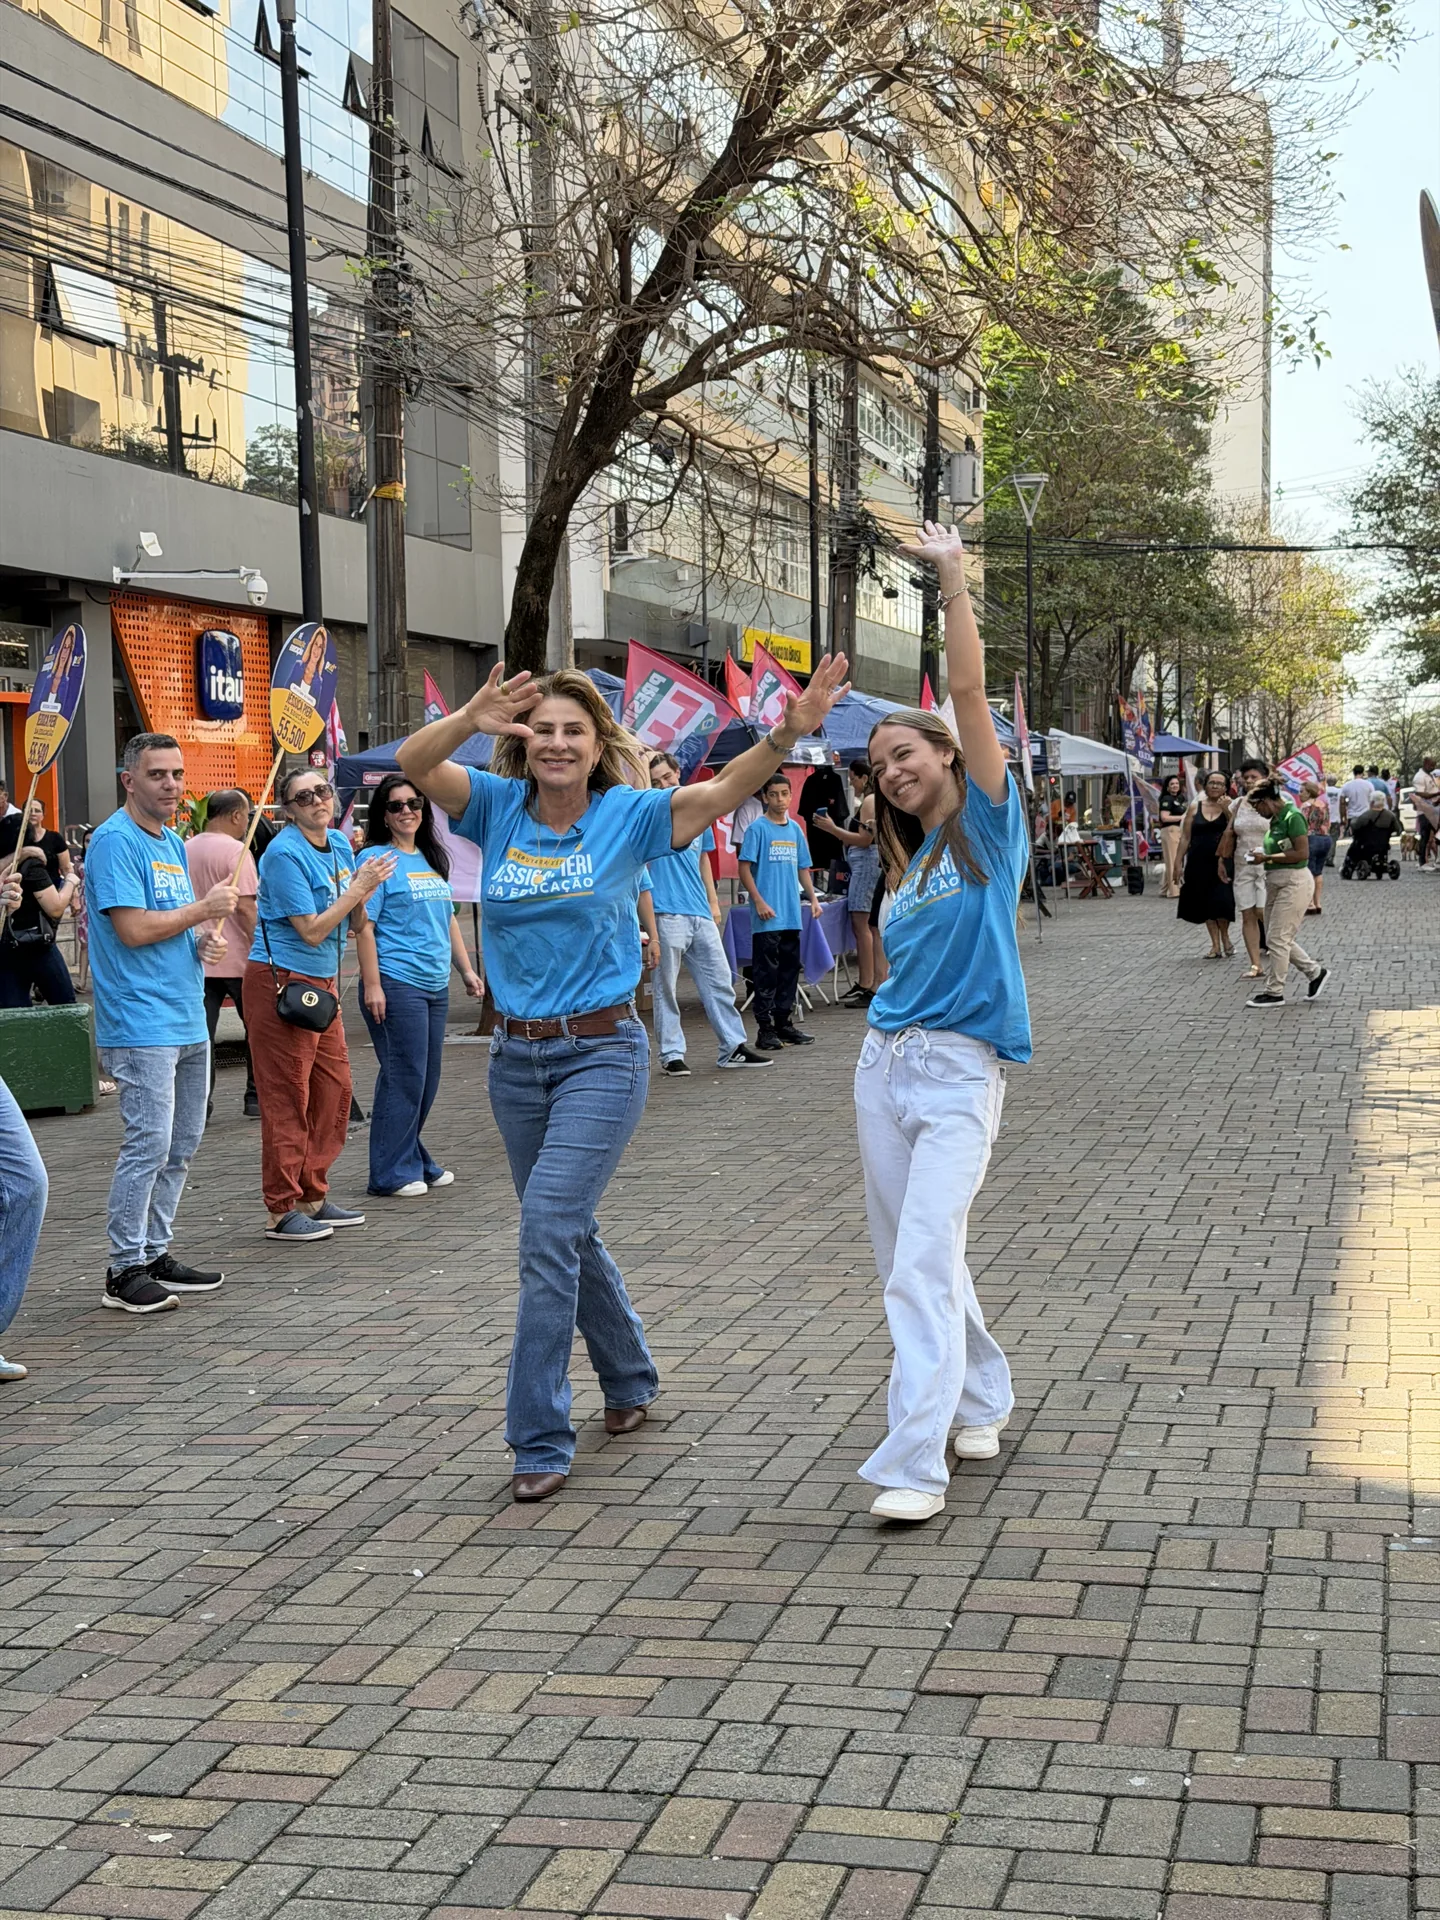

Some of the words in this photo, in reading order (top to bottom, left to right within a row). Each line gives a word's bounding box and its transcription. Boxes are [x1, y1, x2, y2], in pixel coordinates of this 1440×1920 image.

[210, 665, 243, 703] itaú
[277, 716, 306, 750] 55.500
[1281, 761, 1313, 782] LUL
[561, 854, 593, 877] IERI
[155, 890, 169, 899] DA
[488, 884, 504, 897] DA
[509, 877, 594, 897] EDUCAÇÃO
